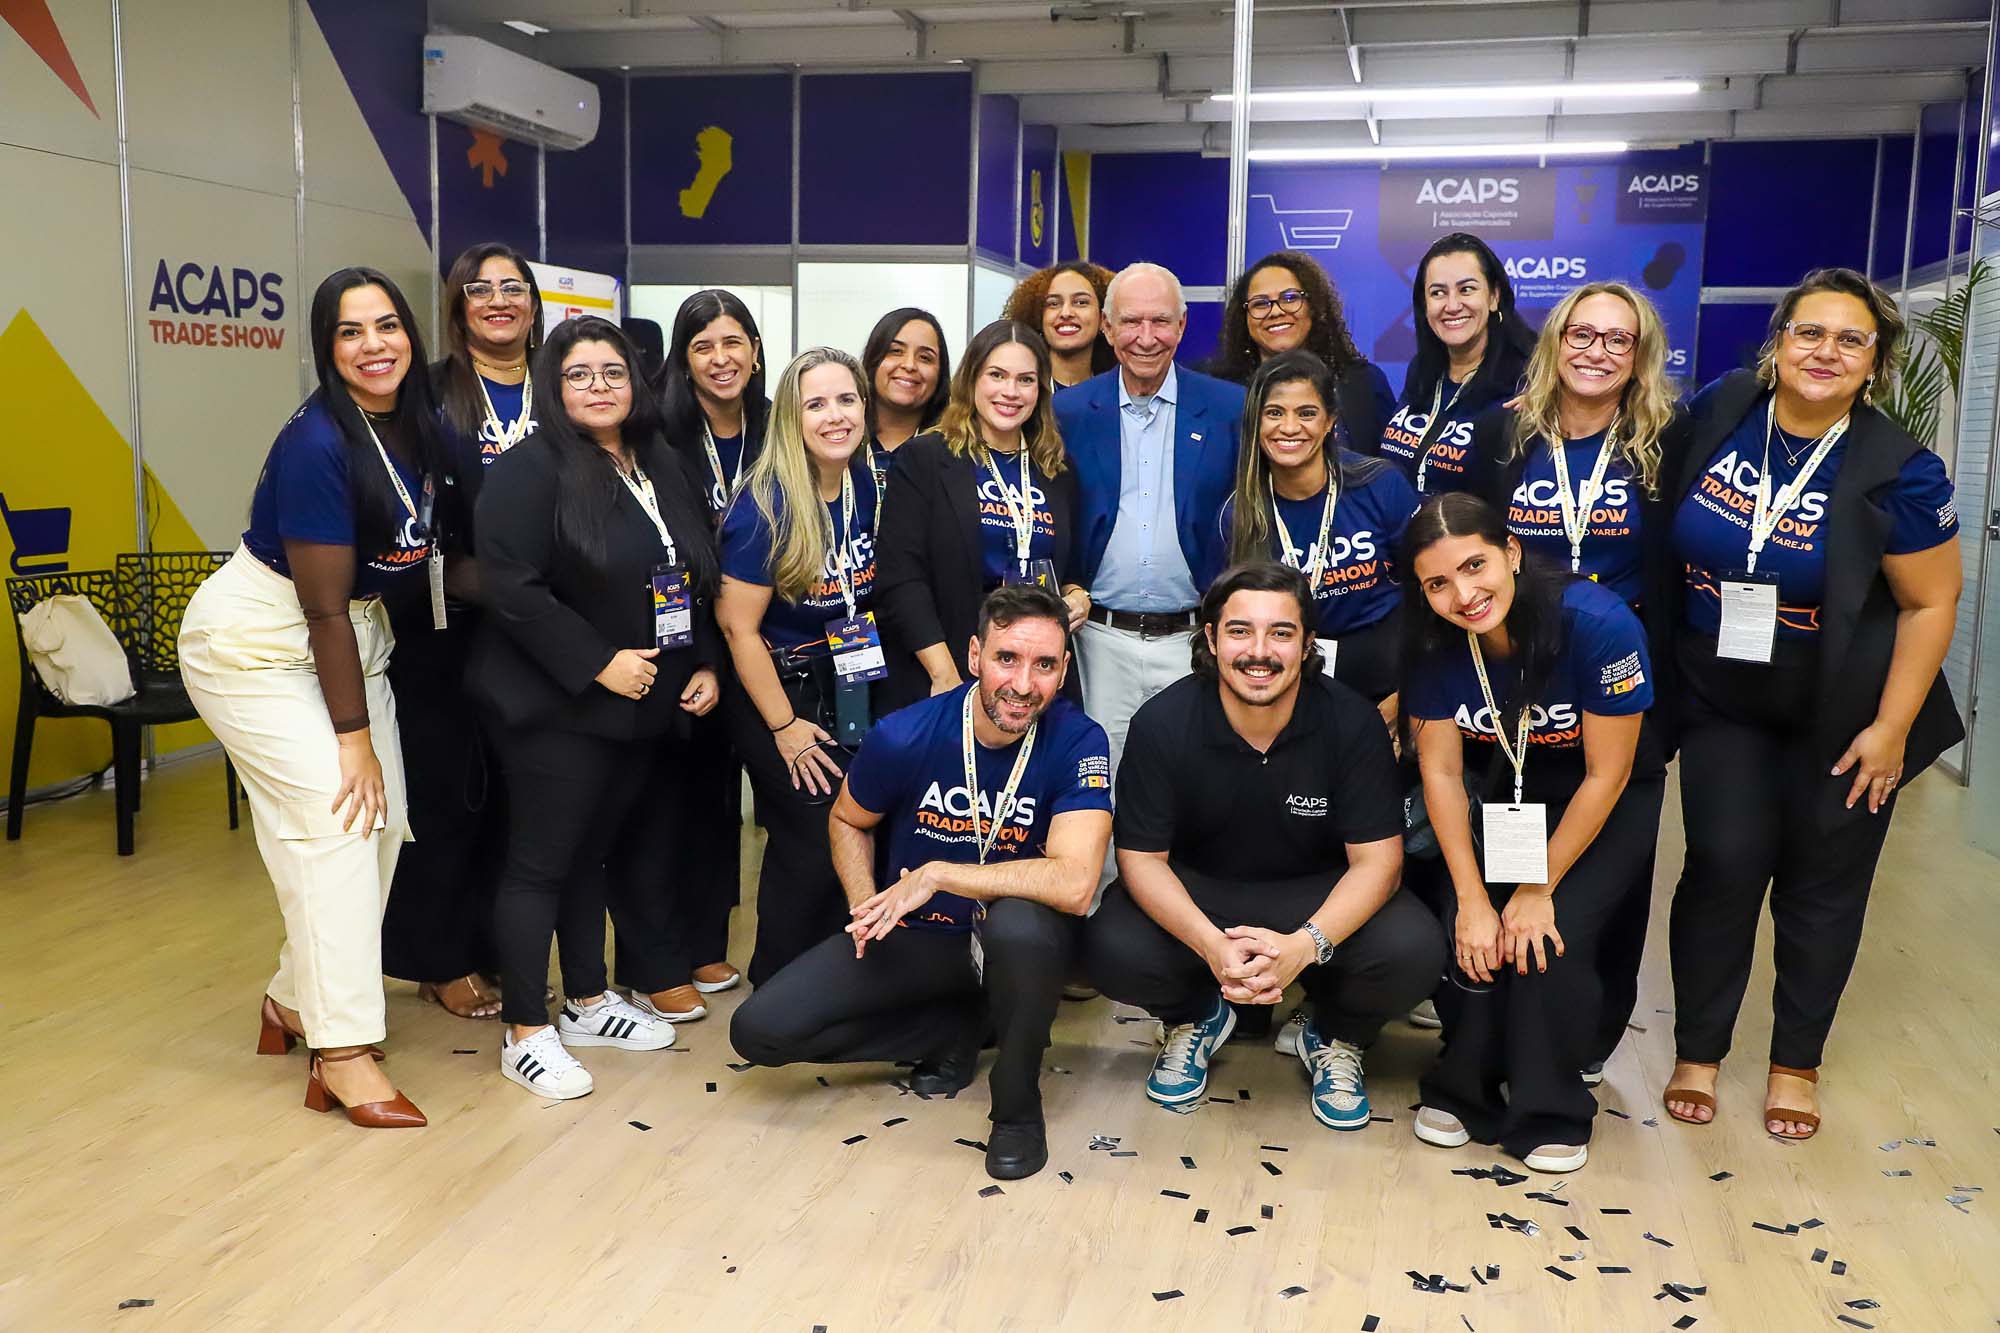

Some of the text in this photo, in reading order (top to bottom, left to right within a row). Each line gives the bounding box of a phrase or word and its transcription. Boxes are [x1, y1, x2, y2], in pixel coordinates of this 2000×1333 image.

[1415, 178, 1519, 204] ACAPS
[1627, 175, 1699, 193] ACAPS
[1504, 257, 1587, 279] ACAPS
[149, 259, 285, 321] ACAPS
[149, 320, 285, 350] TRADE SHOW
[1388, 404, 1474, 446] ACPS
[1701, 475, 1755, 514] TRADE
[1508, 506, 1561, 524] TRADE
[1692, 492, 1748, 530] APAIXONADOS
[1329, 587, 1349, 596] PELO
[1455, 704, 1577, 733] ACPS
[919, 781, 1036, 826] ACAPS
[1285, 794, 1328, 808] ACAPS
[917, 811, 975, 832] TRADE
[914, 828, 978, 844] APAIXONADOS
